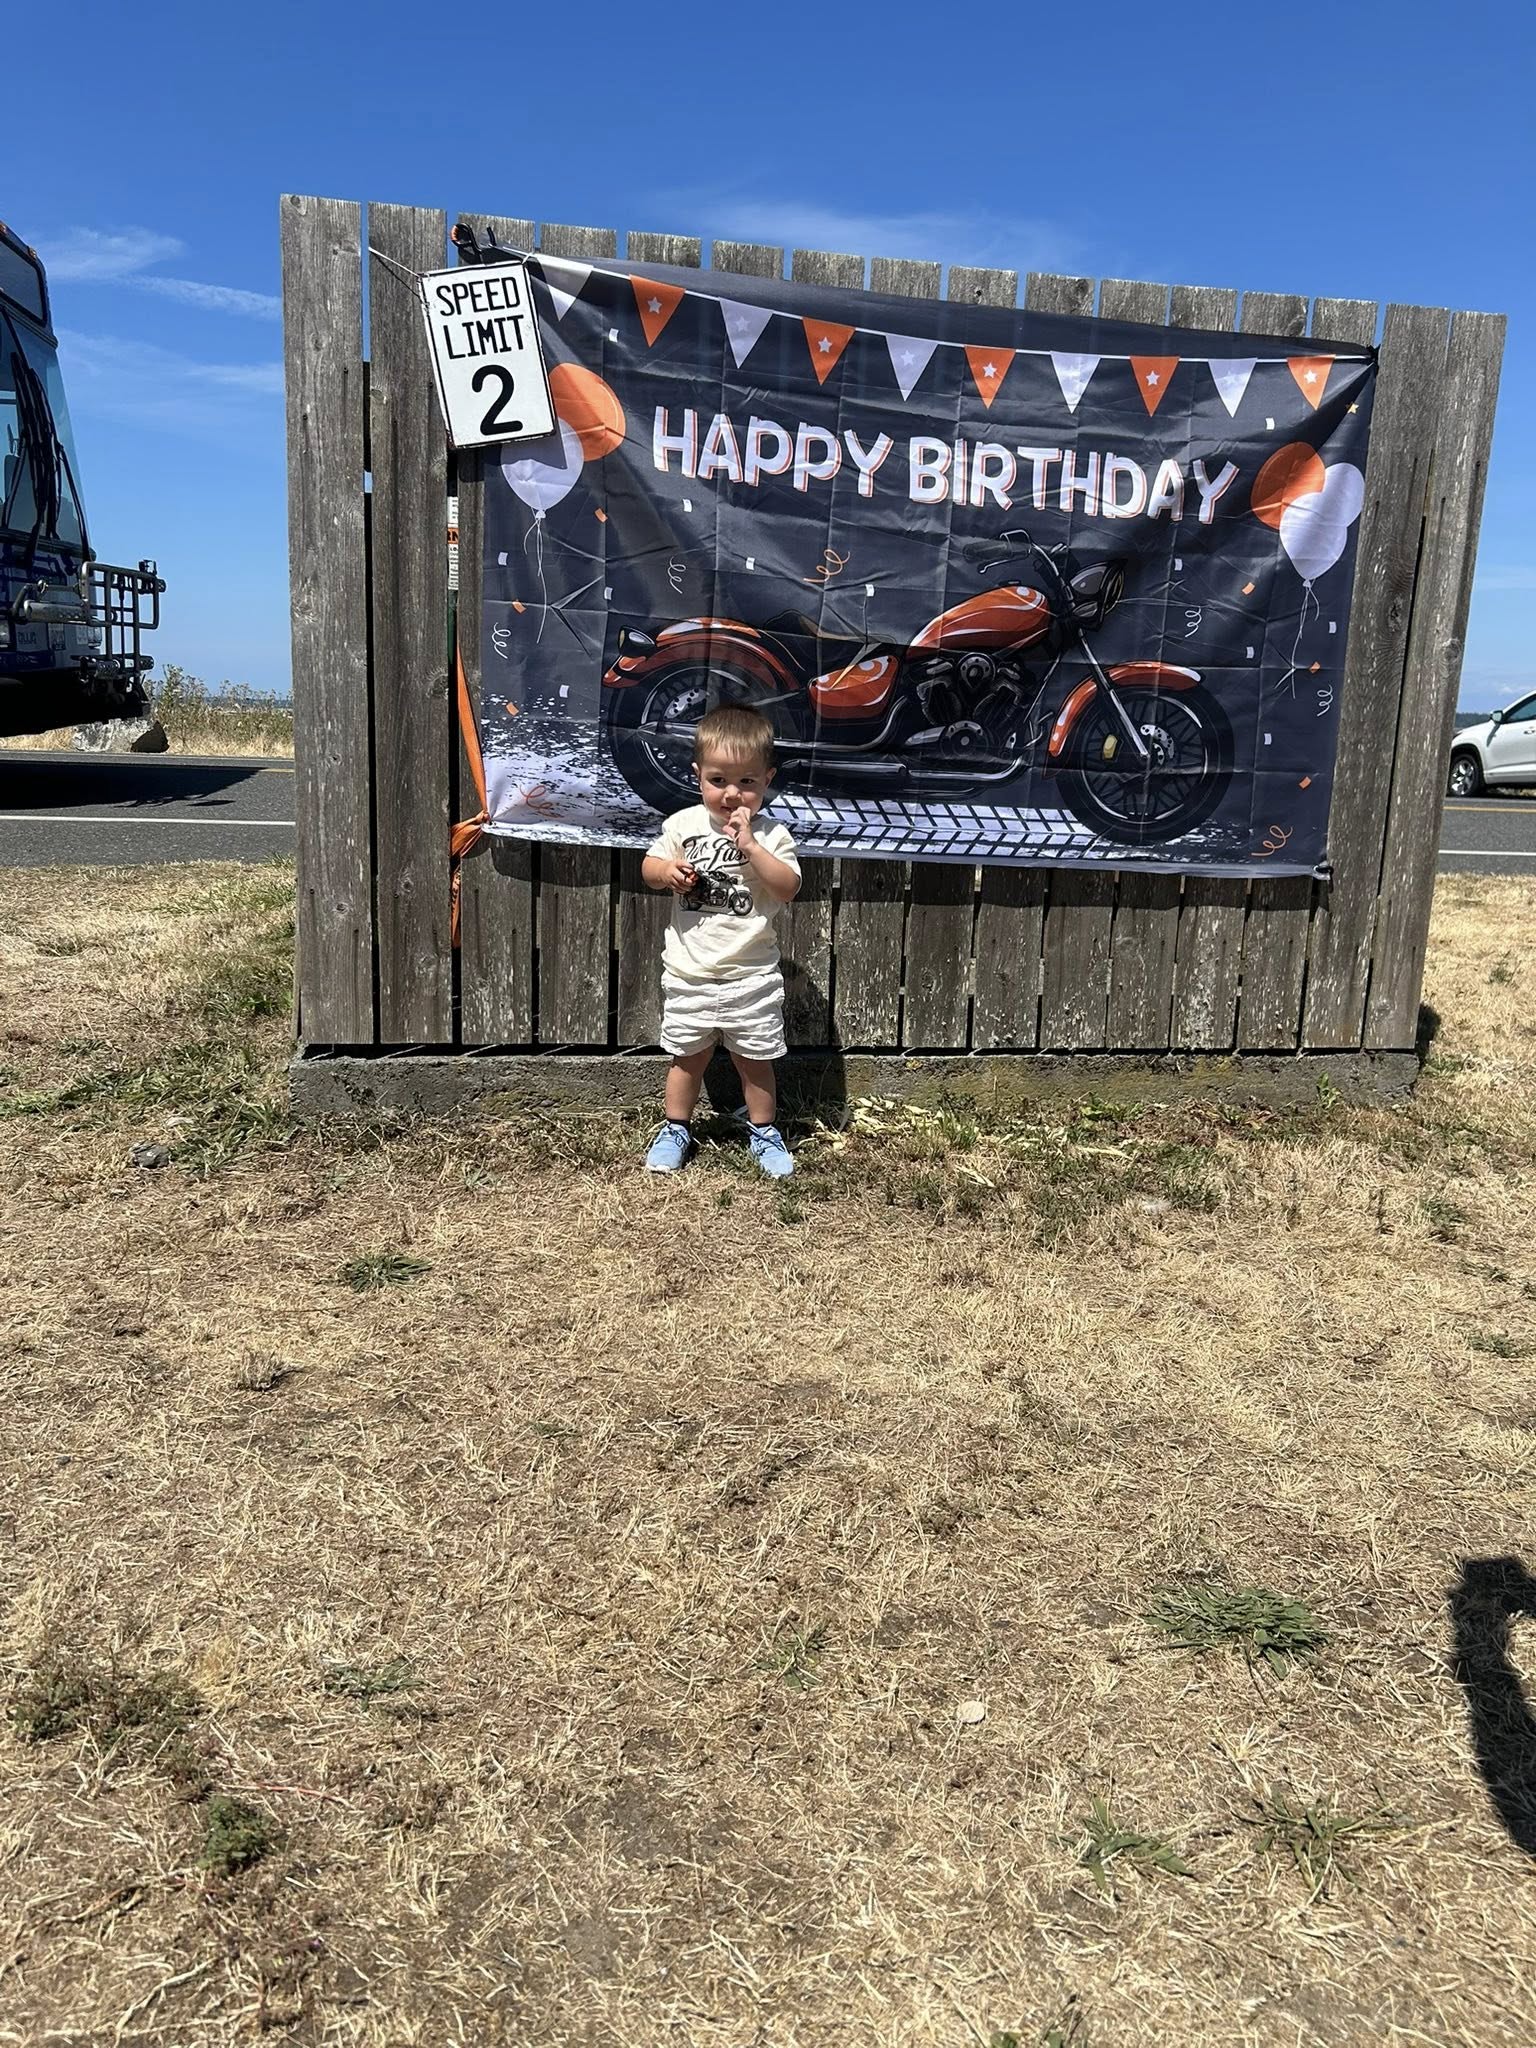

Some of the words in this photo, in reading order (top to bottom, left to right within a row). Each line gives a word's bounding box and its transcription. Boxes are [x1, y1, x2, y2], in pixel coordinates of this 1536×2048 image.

[436, 277, 521, 316] SPEED
[443, 315, 523, 359] LIMIT
[472, 364, 523, 435] 2
[653, 405, 894, 498] HAPPY
[909, 436, 1240, 524] BIRTHDAY
